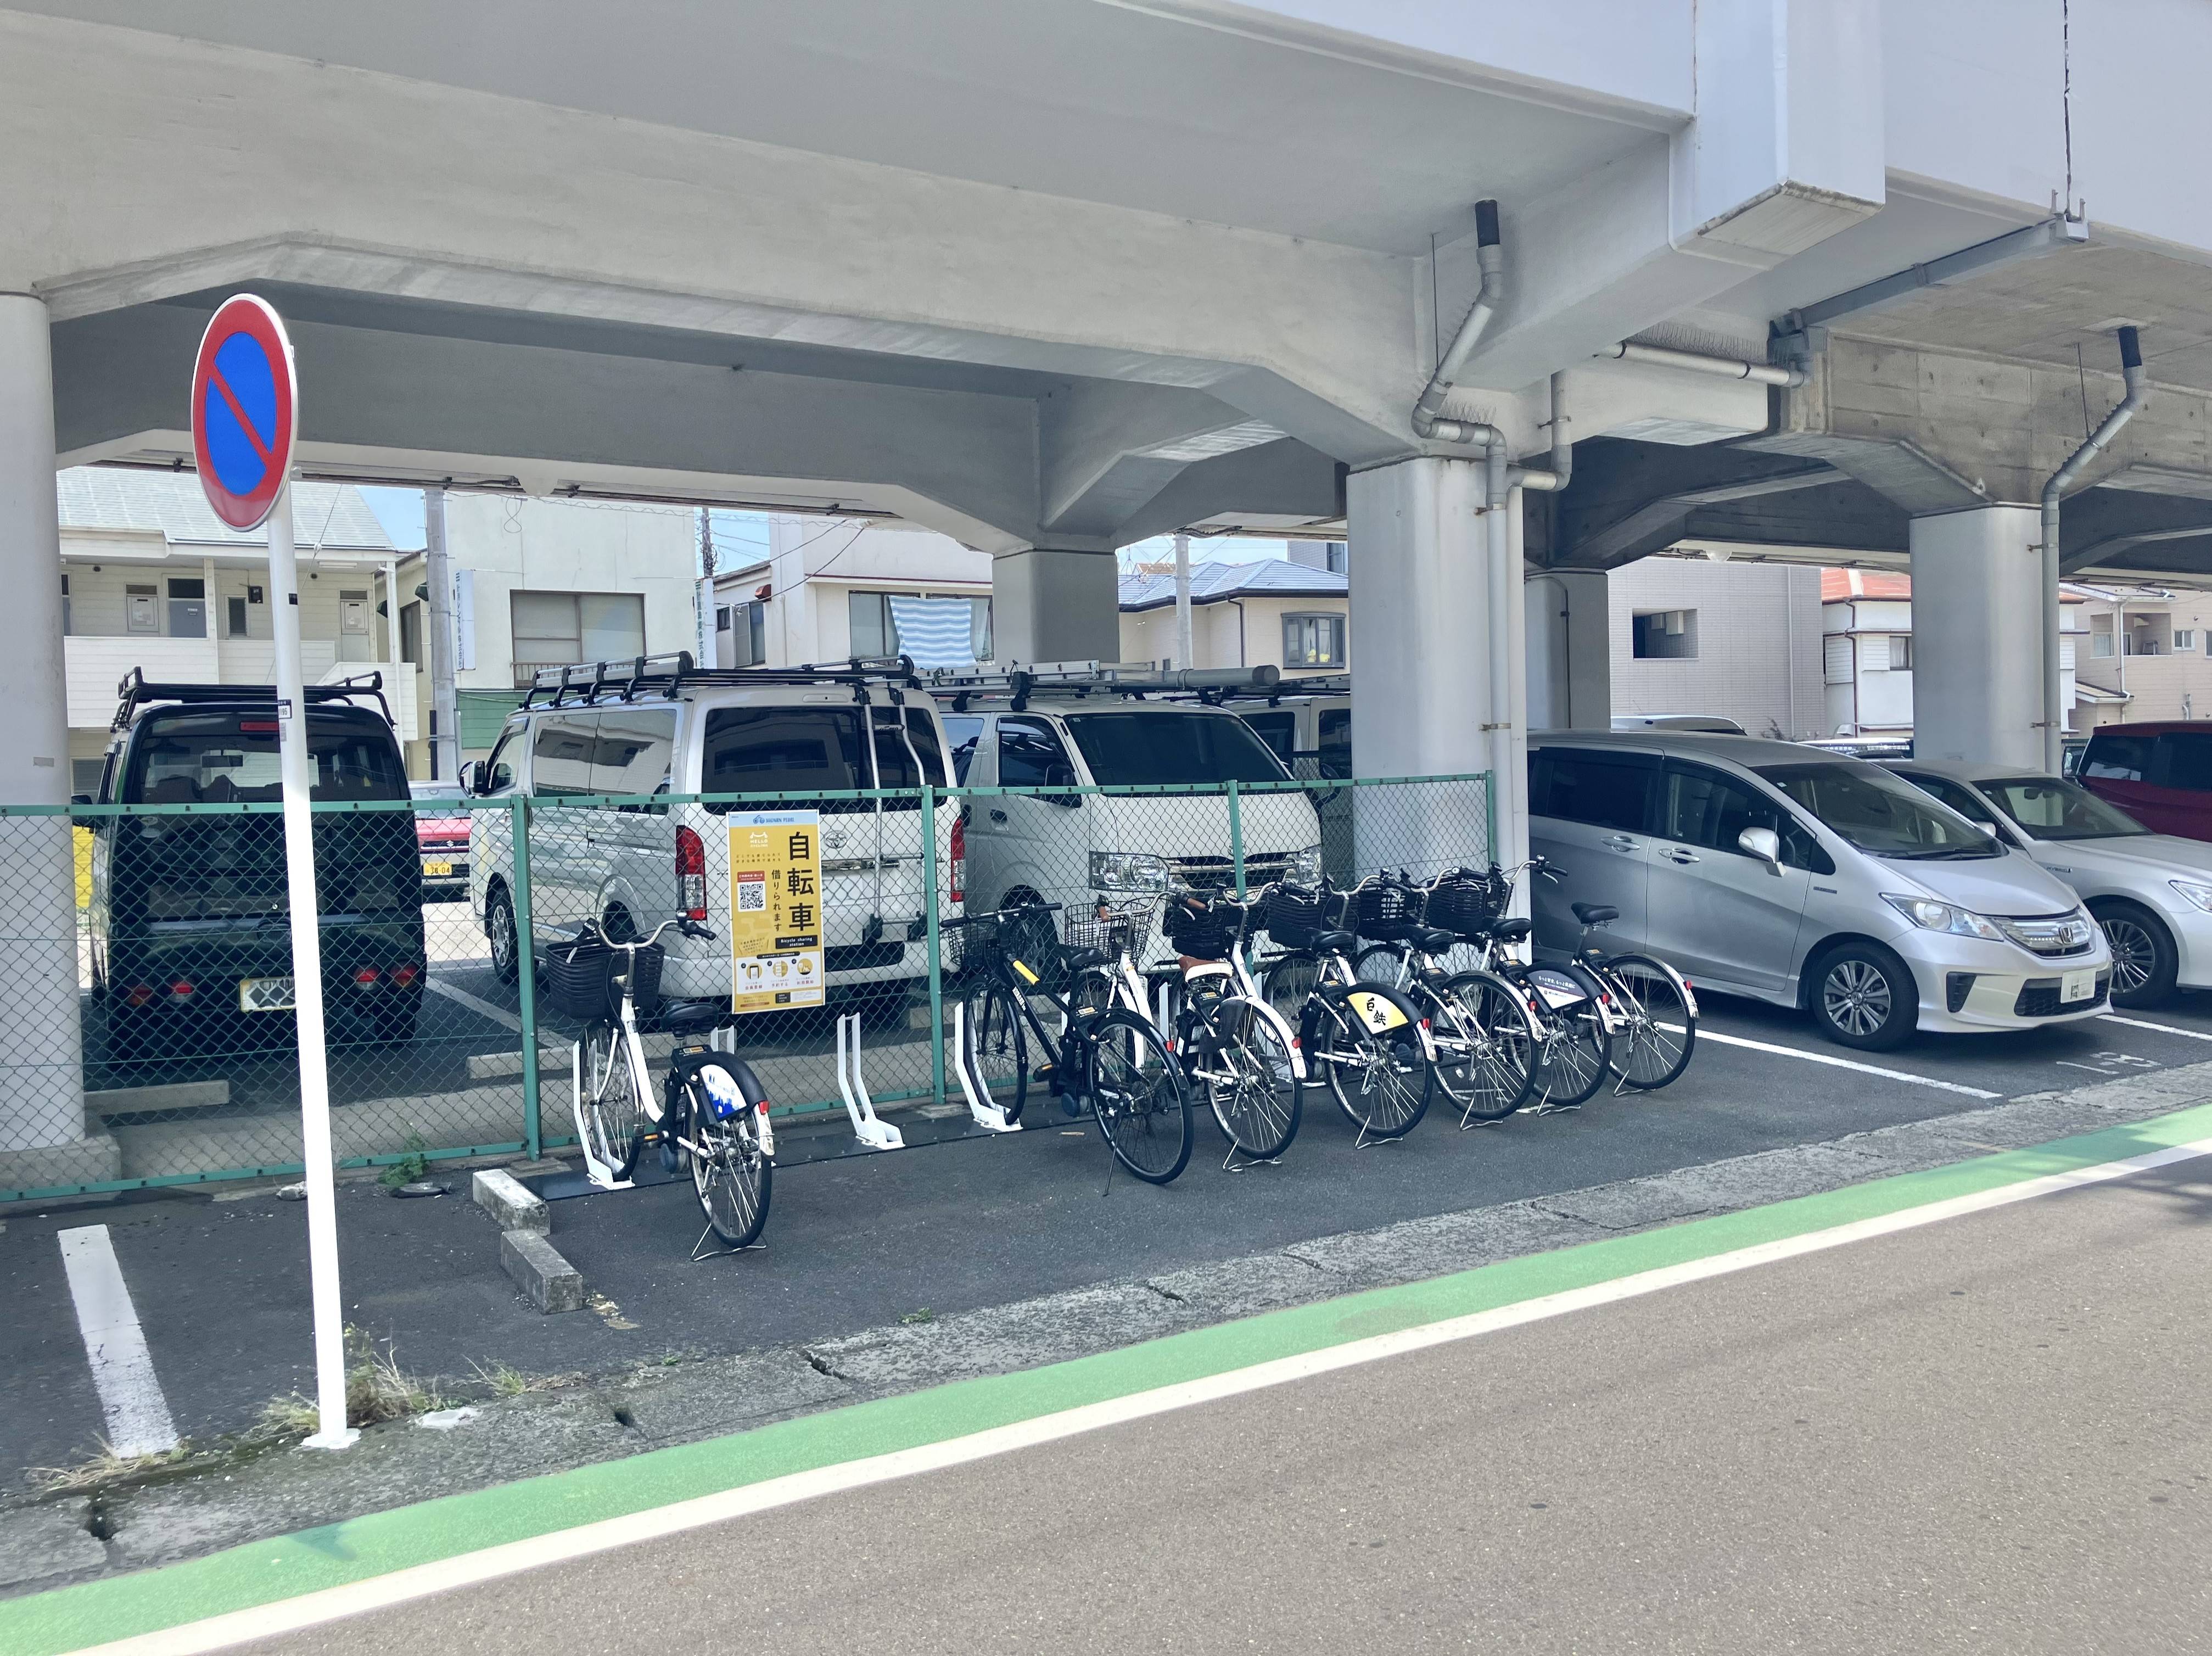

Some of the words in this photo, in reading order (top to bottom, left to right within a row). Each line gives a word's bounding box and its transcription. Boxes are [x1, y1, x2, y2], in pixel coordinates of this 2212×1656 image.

[771, 869, 782, 932] 借りられます
[787, 831, 815, 932] 自転車
